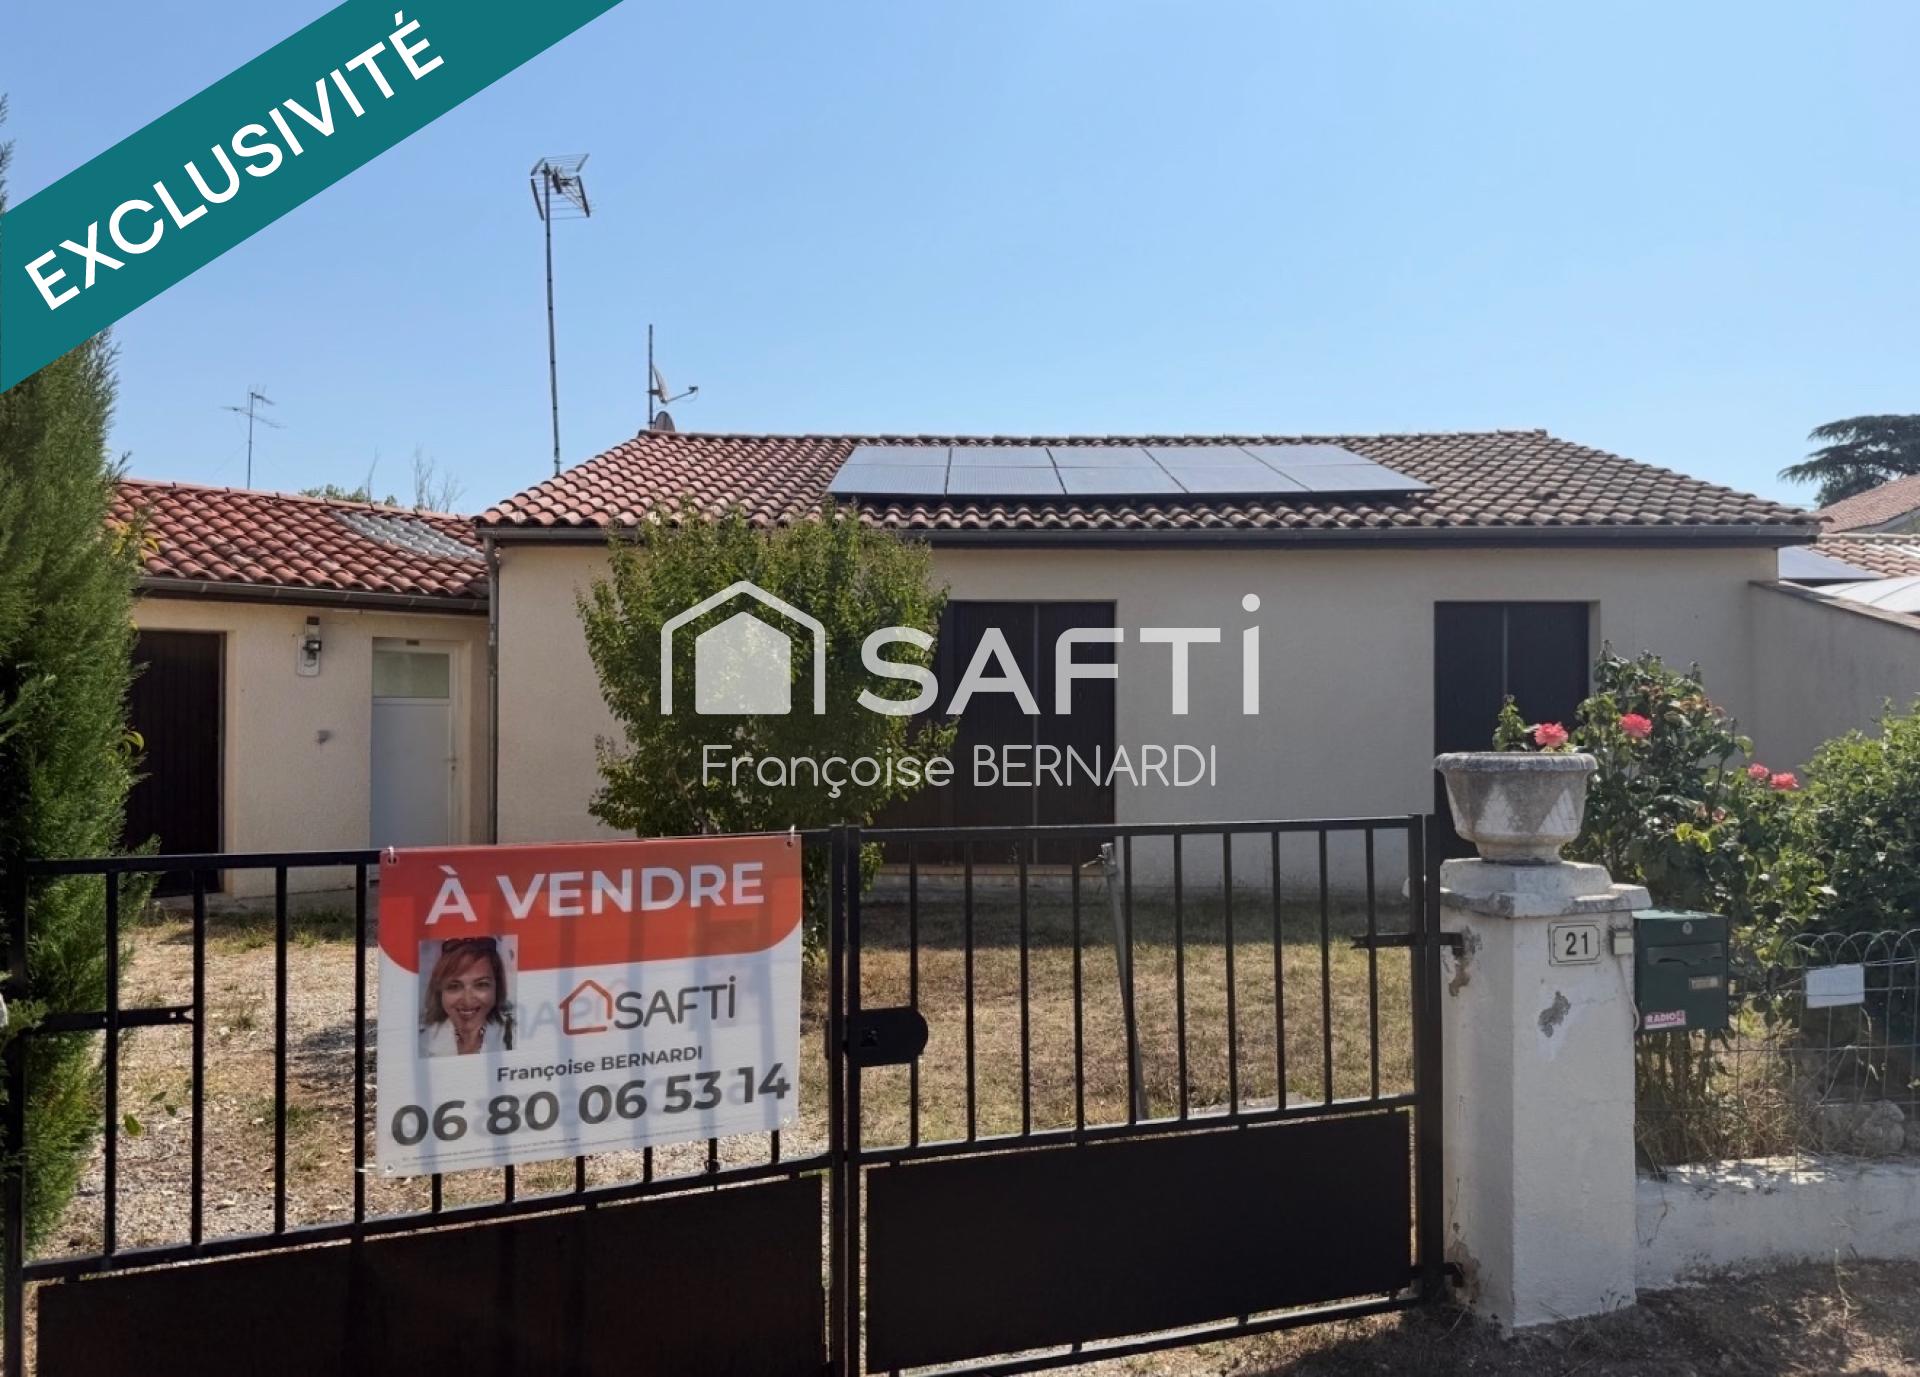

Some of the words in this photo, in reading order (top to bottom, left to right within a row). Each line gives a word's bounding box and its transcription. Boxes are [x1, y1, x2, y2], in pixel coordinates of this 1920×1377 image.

[426, 865, 478, 925] À
[497, 862, 764, 919] VENDRE
[1565, 931, 1589, 955] 21
[497, 1059, 595, 1082] Françoise
[601, 1046, 703, 1070] BERNARDI
[391, 1100, 467, 1146] 06
[486, 1092, 560, 1135] 80
[578, 1080, 648, 1124] 06
[662, 1071, 722, 1114] 53
[736, 1063, 791, 1104] 14
